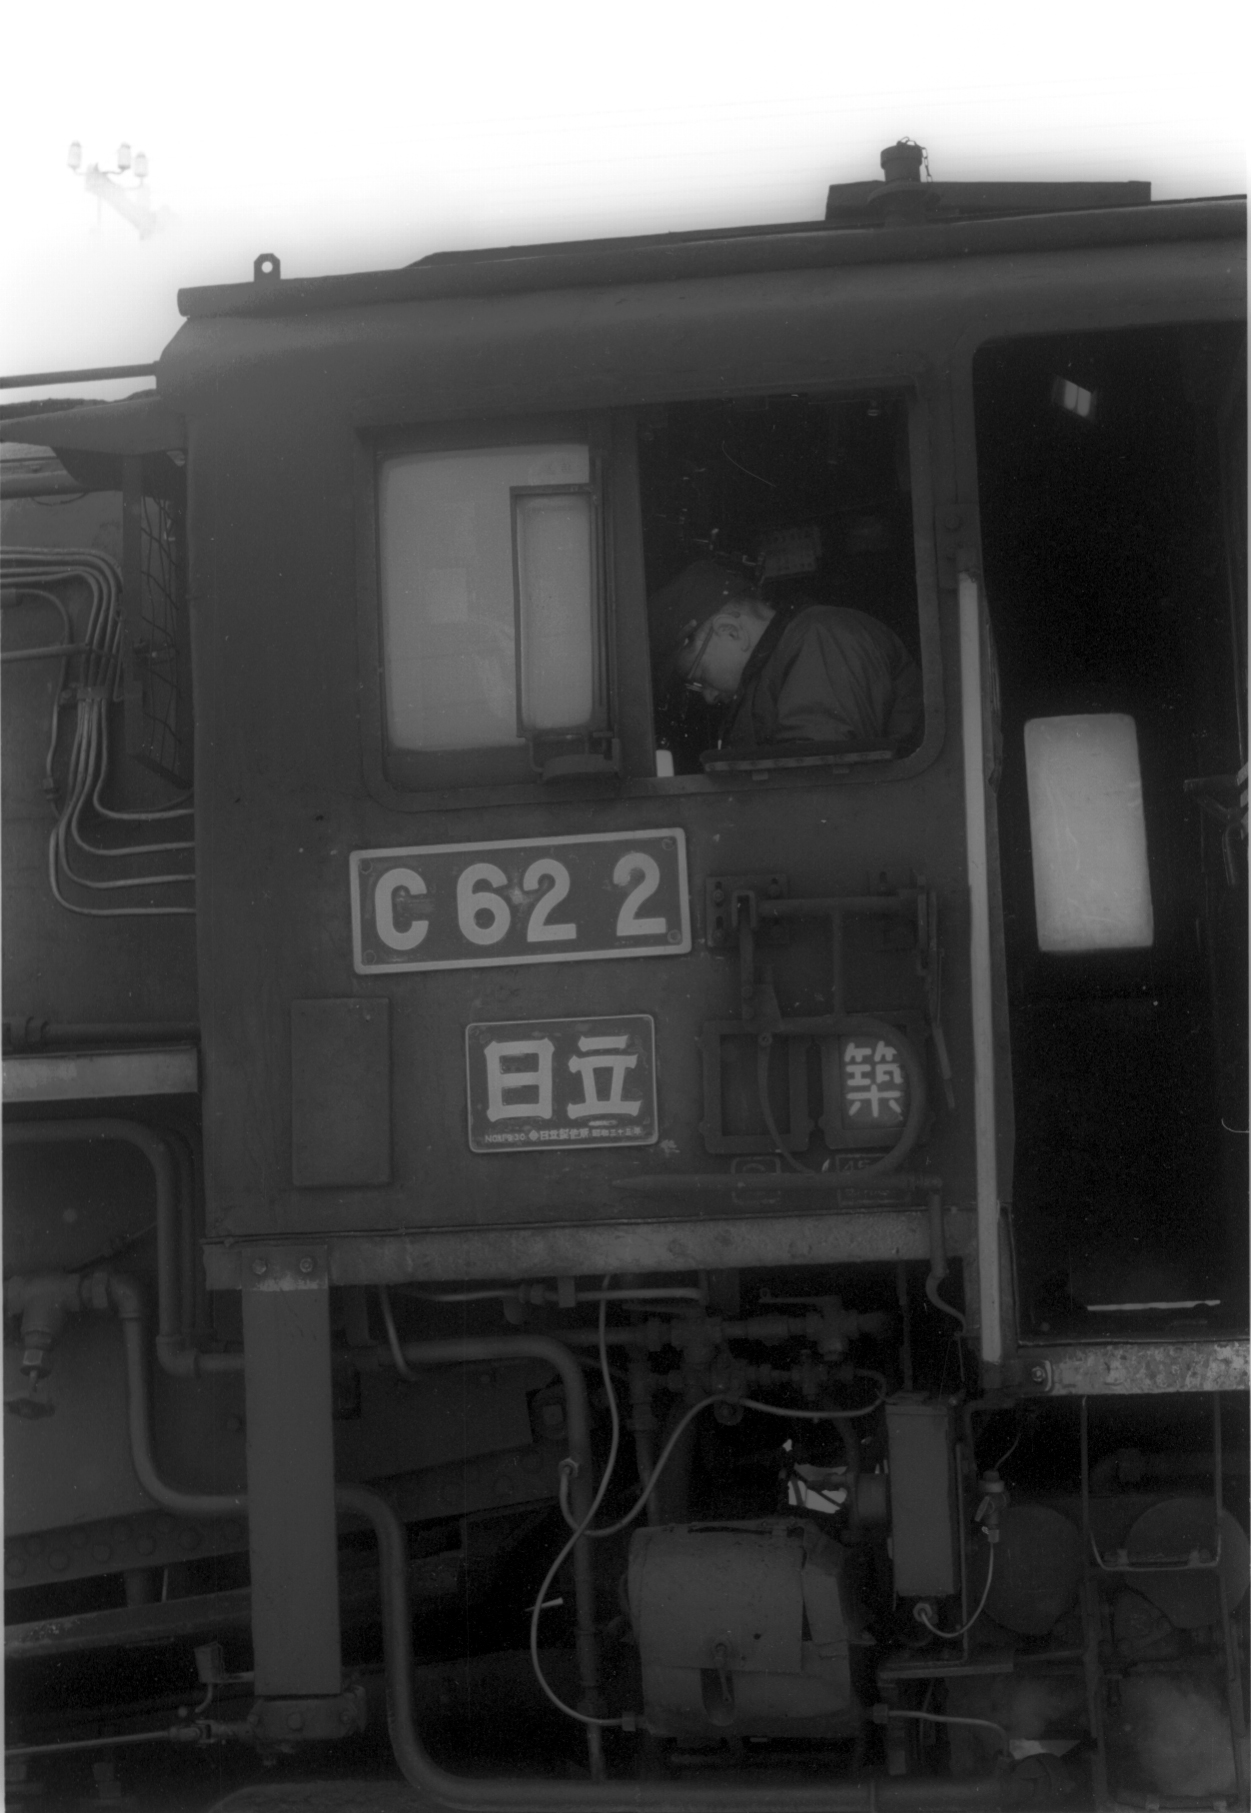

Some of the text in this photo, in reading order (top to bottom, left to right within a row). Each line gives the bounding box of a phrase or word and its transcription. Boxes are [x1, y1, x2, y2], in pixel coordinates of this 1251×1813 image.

[612, 852, 667, 937] 2
[483, 1034, 643, 1123] 日立
[844, 1040, 905, 1119] 築
